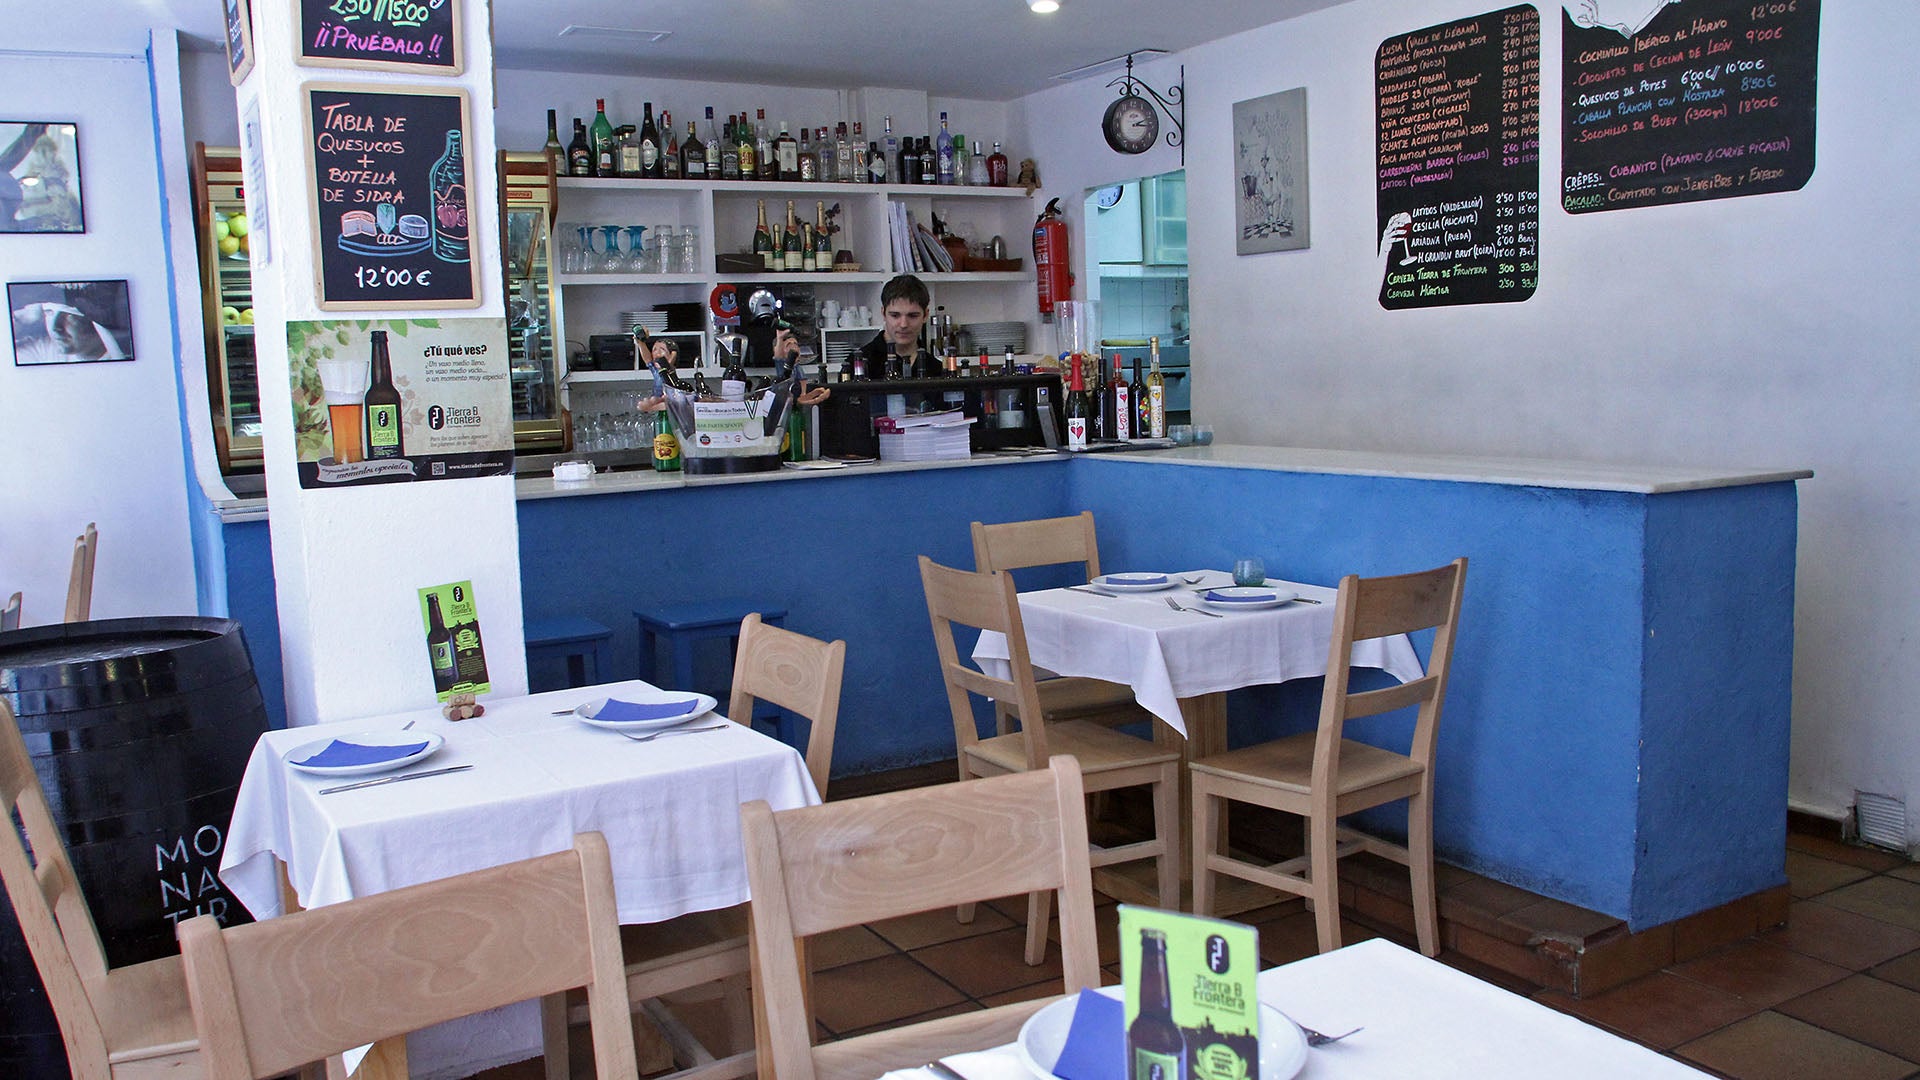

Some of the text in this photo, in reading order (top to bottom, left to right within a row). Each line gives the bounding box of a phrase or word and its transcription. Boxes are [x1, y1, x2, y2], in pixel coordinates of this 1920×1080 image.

[1674, 28, 1688, 42] AL
[1578, 90, 1620, 108] QUESUCOS
[1623, 86, 1635, 97] DE
[1639, 79, 1667, 92] POTES
[321, 102, 407, 133] TABLA DE
[317, 132, 405, 154] QUESUCOS
[328, 168, 397, 185] BOTELLA
[322, 188, 405, 204] DE SIDRA
[424, 344, 487, 358] ¿Tú qué ves?
